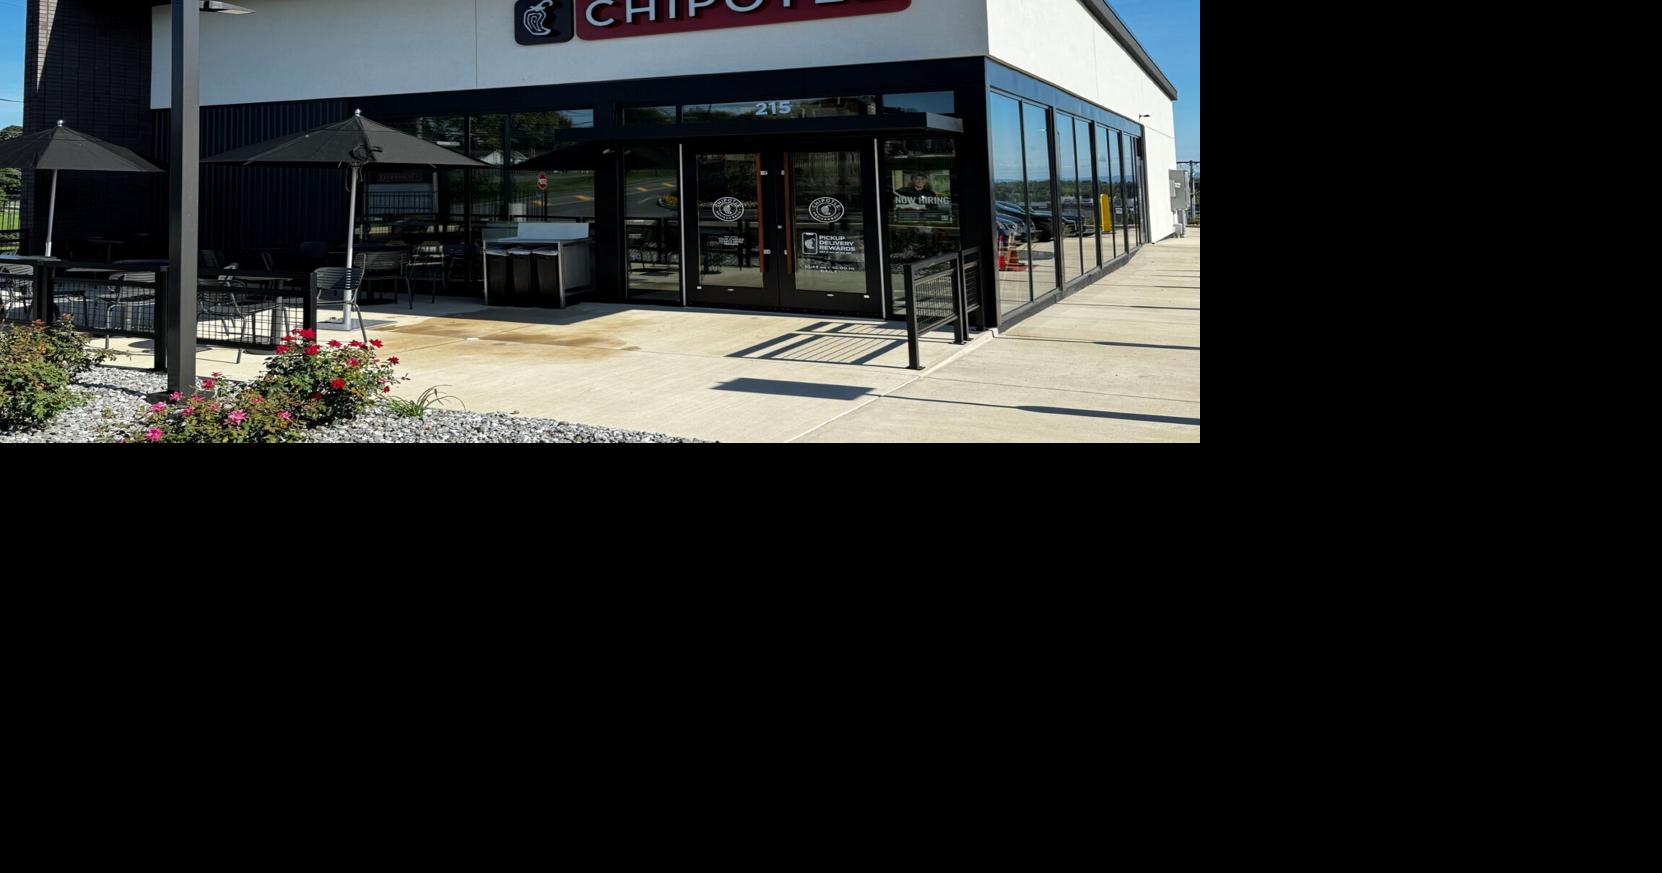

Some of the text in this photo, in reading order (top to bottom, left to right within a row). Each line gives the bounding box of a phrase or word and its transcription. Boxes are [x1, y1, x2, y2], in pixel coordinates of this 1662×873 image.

[755, 100, 791, 115] 215
[895, 196, 951, 205] NOW HIRING
